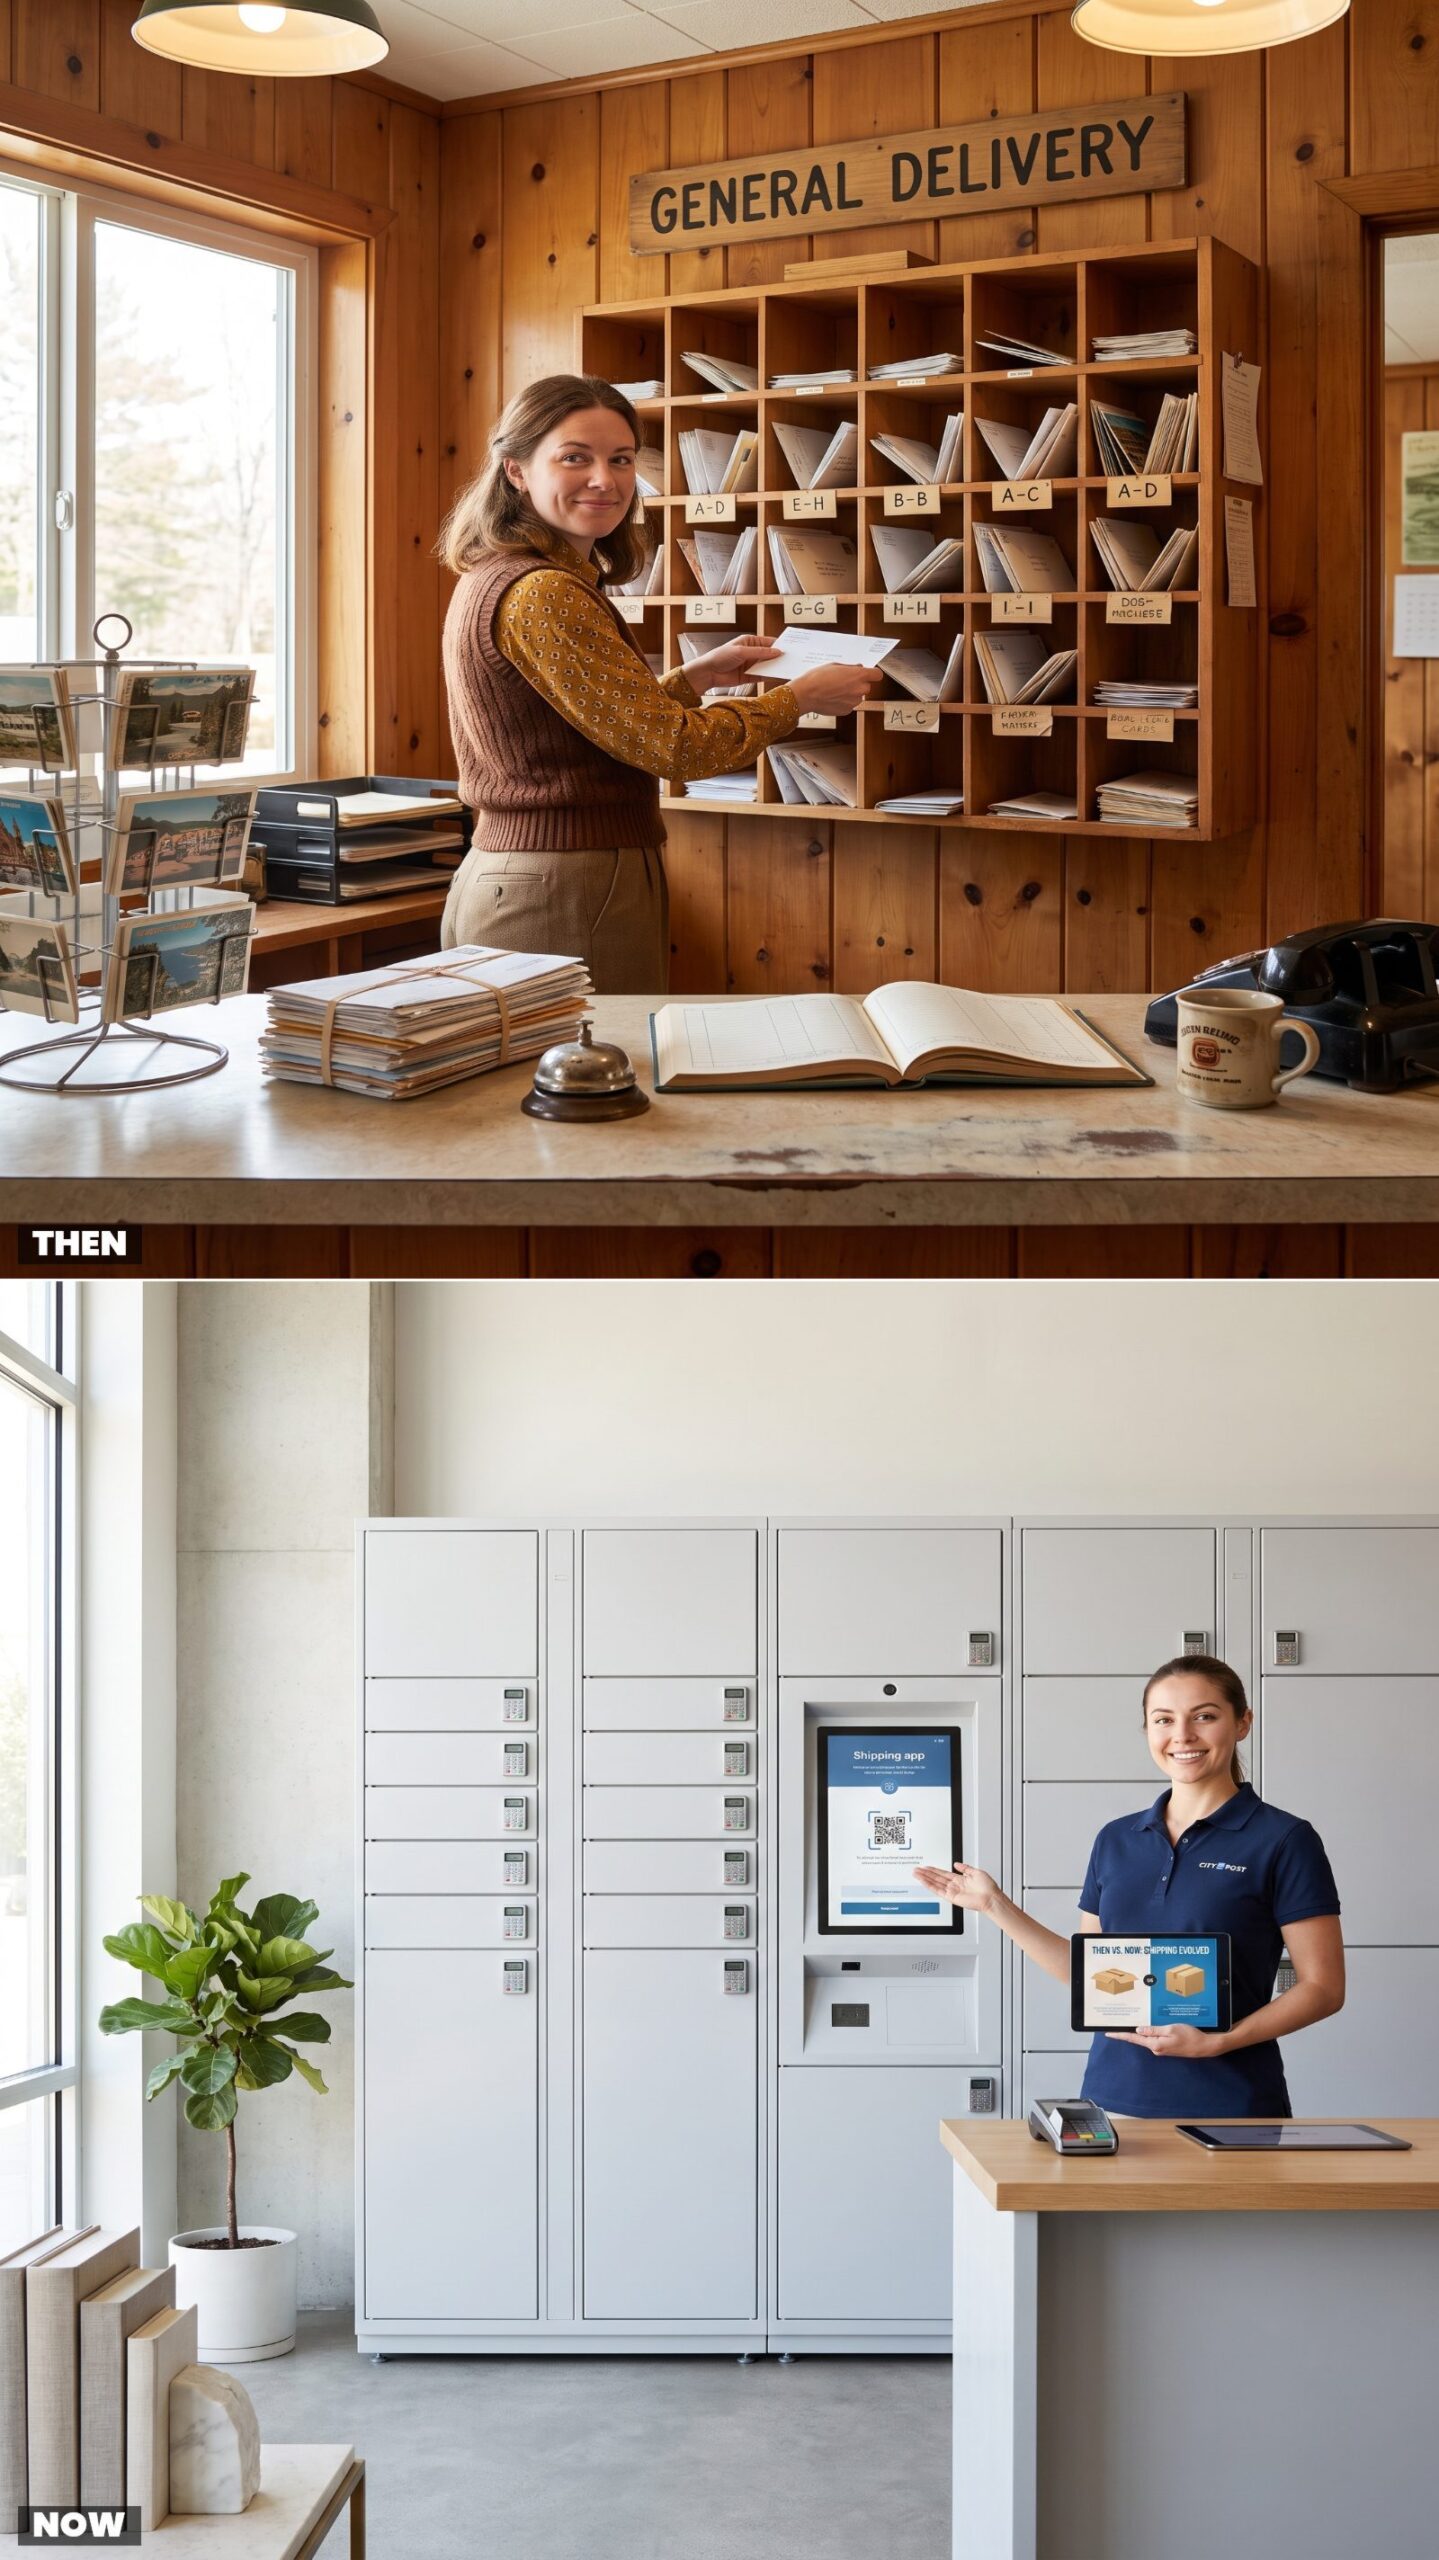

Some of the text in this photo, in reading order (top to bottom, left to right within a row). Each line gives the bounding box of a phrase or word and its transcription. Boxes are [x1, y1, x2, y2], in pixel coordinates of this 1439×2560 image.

[650, 116, 1154, 234] GENERAL DELIVERY
[1002, 487, 1039, 503] A-C
[1118, 482, 1157, 498] A-D
[793, 496, 824, 511] E-H
[894, 492, 928, 507] B-B
[695, 501, 724, 515] A-D
[694, 603, 724, 616] B-T
[792, 602, 825, 615] G-G
[853, 1750, 925, 1762] Shipping app
[1225, 1864, 1247, 1873] POST
[1092, 1946, 1210, 1955] THEN VS. NOW: SHIPPING EVOLVED
